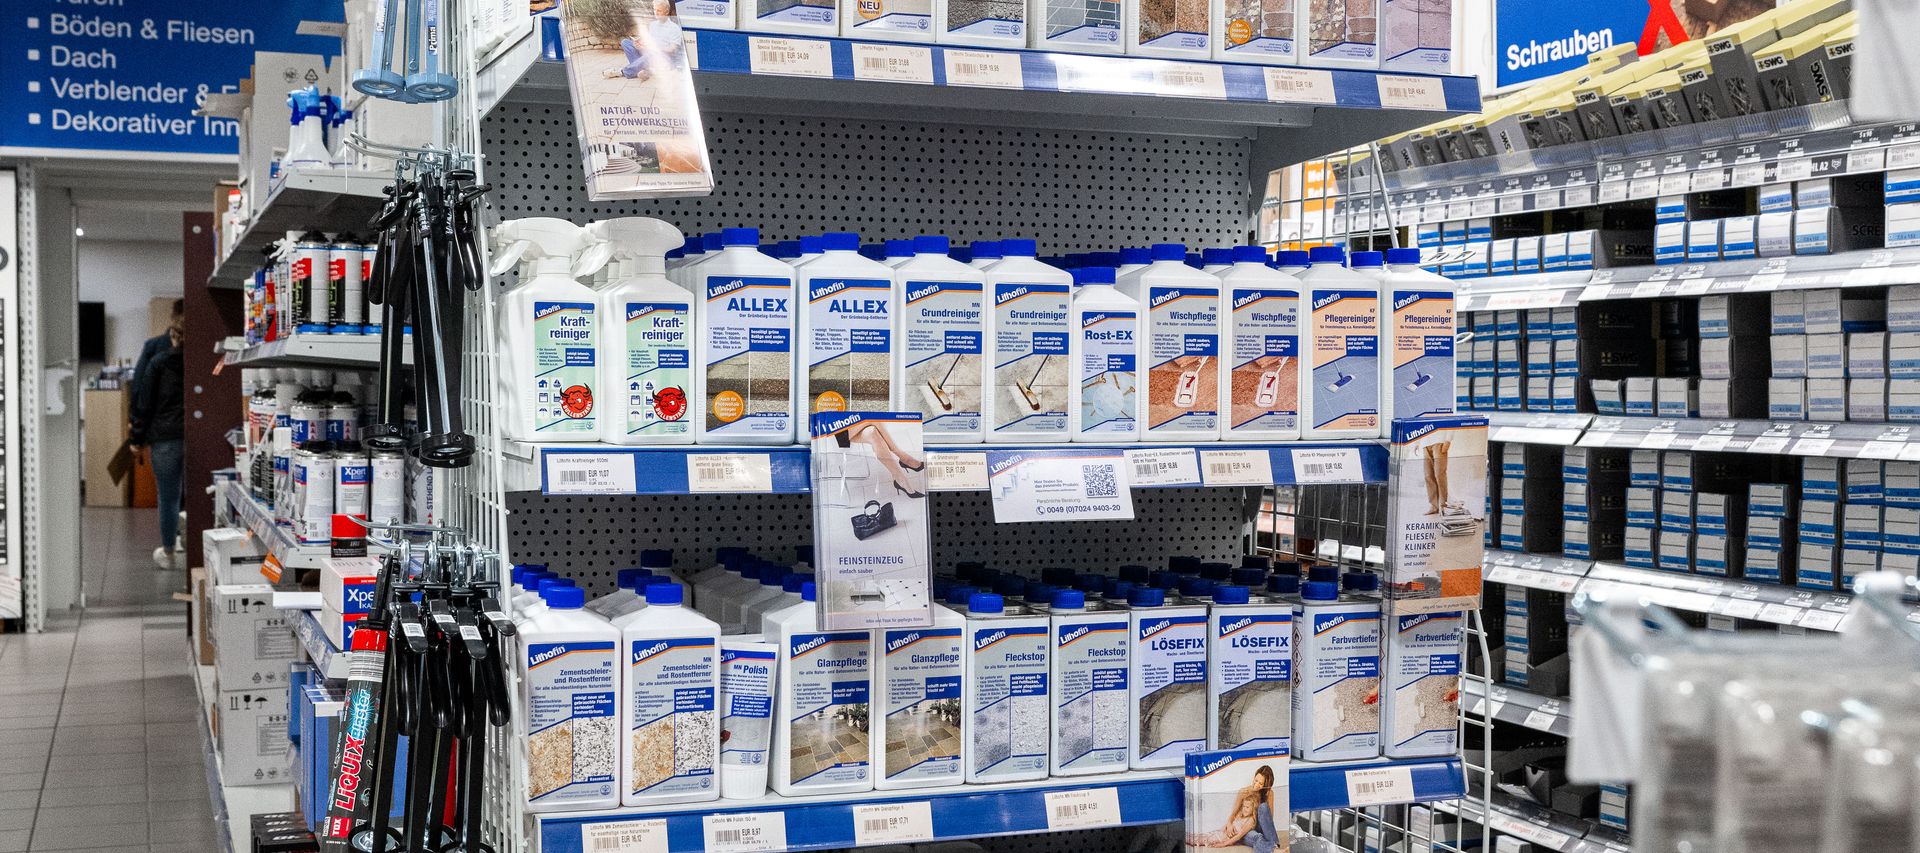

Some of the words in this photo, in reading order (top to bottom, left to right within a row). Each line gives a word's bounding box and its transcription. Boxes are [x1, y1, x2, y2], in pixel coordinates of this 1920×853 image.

[859, 1, 881, 11] NEU
[50, 13, 132, 38] Böden
[140, 18, 159, 39] &
[167, 20, 255, 44] Fliesen
[1506, 26, 1613, 70] Schrauben
[1714, 40, 1732, 53] SWG
[51, 46, 117, 69] Dach
[1764, 56, 1784, 68] SWG
[1687, 70, 1705, 84] SWG
[50, 77, 189, 103] Verblender
[600, 106, 637, 116] NATUR-
[640, 106, 660, 115] UND
[51, 109, 198, 136] Dekorativer
[602, 117, 689, 127] BETONWERKSTEIN
[709, 280, 743, 297] Lithofin
[811, 281, 844, 299] Lithofin
[908, 284, 940, 301] Lithofin
[997, 286, 1027, 303] Lithofin
[1152, 290, 1180, 306] Lithofin
[1234, 291, 1262, 308] Lithofin
[1314, 292, 1341, 309] Lithofin
[1394, 293, 1420, 310] Lithofin
[536, 304, 561, 318] Lithofin
[727, 298, 788, 312] ALLEX
[829, 299, 888, 313] ALLEX
[627, 305, 654, 319] Lithofin
[921, 308, 980, 320] Grundreiniger
[1010, 310, 1067, 321] Grundreiniger
[1169, 311, 1217, 322] Wischpflege
[1251, 313, 1297, 323] Wischpflege
[560, 315, 590, 327] Kraft-
[653, 316, 684, 328] Kraft-
[1083, 313, 1105, 327] Lithofin
[1324, 314, 1376, 324] Pflegereiniger
[1404, 314, 1452, 324] Pflegereiniger
[549, 328, 590, 341] reiniger
[642, 329, 684, 342] reiniger
[1085, 329, 1133, 340] Rost-EX
[828, 413, 861, 432] Lithofin
[1406, 424, 1434, 440] Lithofin
[990, 454, 1022, 474] Lithofin
[1159, 462, 1167, 470] EUR
[344, 466, 367, 480] Xpert
[588, 470, 598, 478] EUR
[1046, 506, 1064, 514] 0049
[1065, 505, 1091, 514] (0)7024
[1092, 503, 1120, 512] 9403-20
[1405, 521, 1442, 532] KERAMIK,
[1405, 532, 1437, 542] FLIESEN,
[1404, 542, 1436, 551] KLINKER
[838, 555, 904, 566] FEINSTEINZEUG
[1141, 619, 1170, 637] Lithofin
[1221, 617, 1251, 635] Lithofin
[1316, 615, 1345, 633] Lithofin
[1400, 614, 1428, 630] Lithofin
[888, 632, 920, 651] Lithofin
[976, 630, 1006, 649] Lithofin
[1060, 626, 1089, 644] Lithofin
[1231, 635, 1289, 648] LÖSEFIX
[1331, 636, 1378, 645] Farbvertiefer
[1415, 634, 1460, 643] Farbvertiefer
[792, 636, 826, 655] Lithofin
[1151, 637, 1205, 651] LÖSEFIX
[530, 645, 566, 665] Lithofin
[633, 641, 668, 661] Lithofin
[1005, 652, 1045, 662] Fleckstop
[1088, 648, 1126, 657] Fleckstop
[816, 658, 867, 668] Glanzpflege
[911, 653, 960, 664] Glanzpflege
[560, 668, 612, 676] Zementschleier-
[662, 664, 712, 672] Zementschleier-
[743, 664, 768, 675] Polish
[568, 676, 612, 684] Rostentferner
[670, 671, 712, 679] Rostentferner
[1202, 754, 1233, 774] Lithofin
[1376, 781, 1384, 789] EUR
[1079, 803, 1088, 811] EUR
[332, 818, 342, 836] TOX
[889, 817, 898, 825] EUR
[741, 828, 751, 837] EUR
[621, 836, 630, 844] EUR
